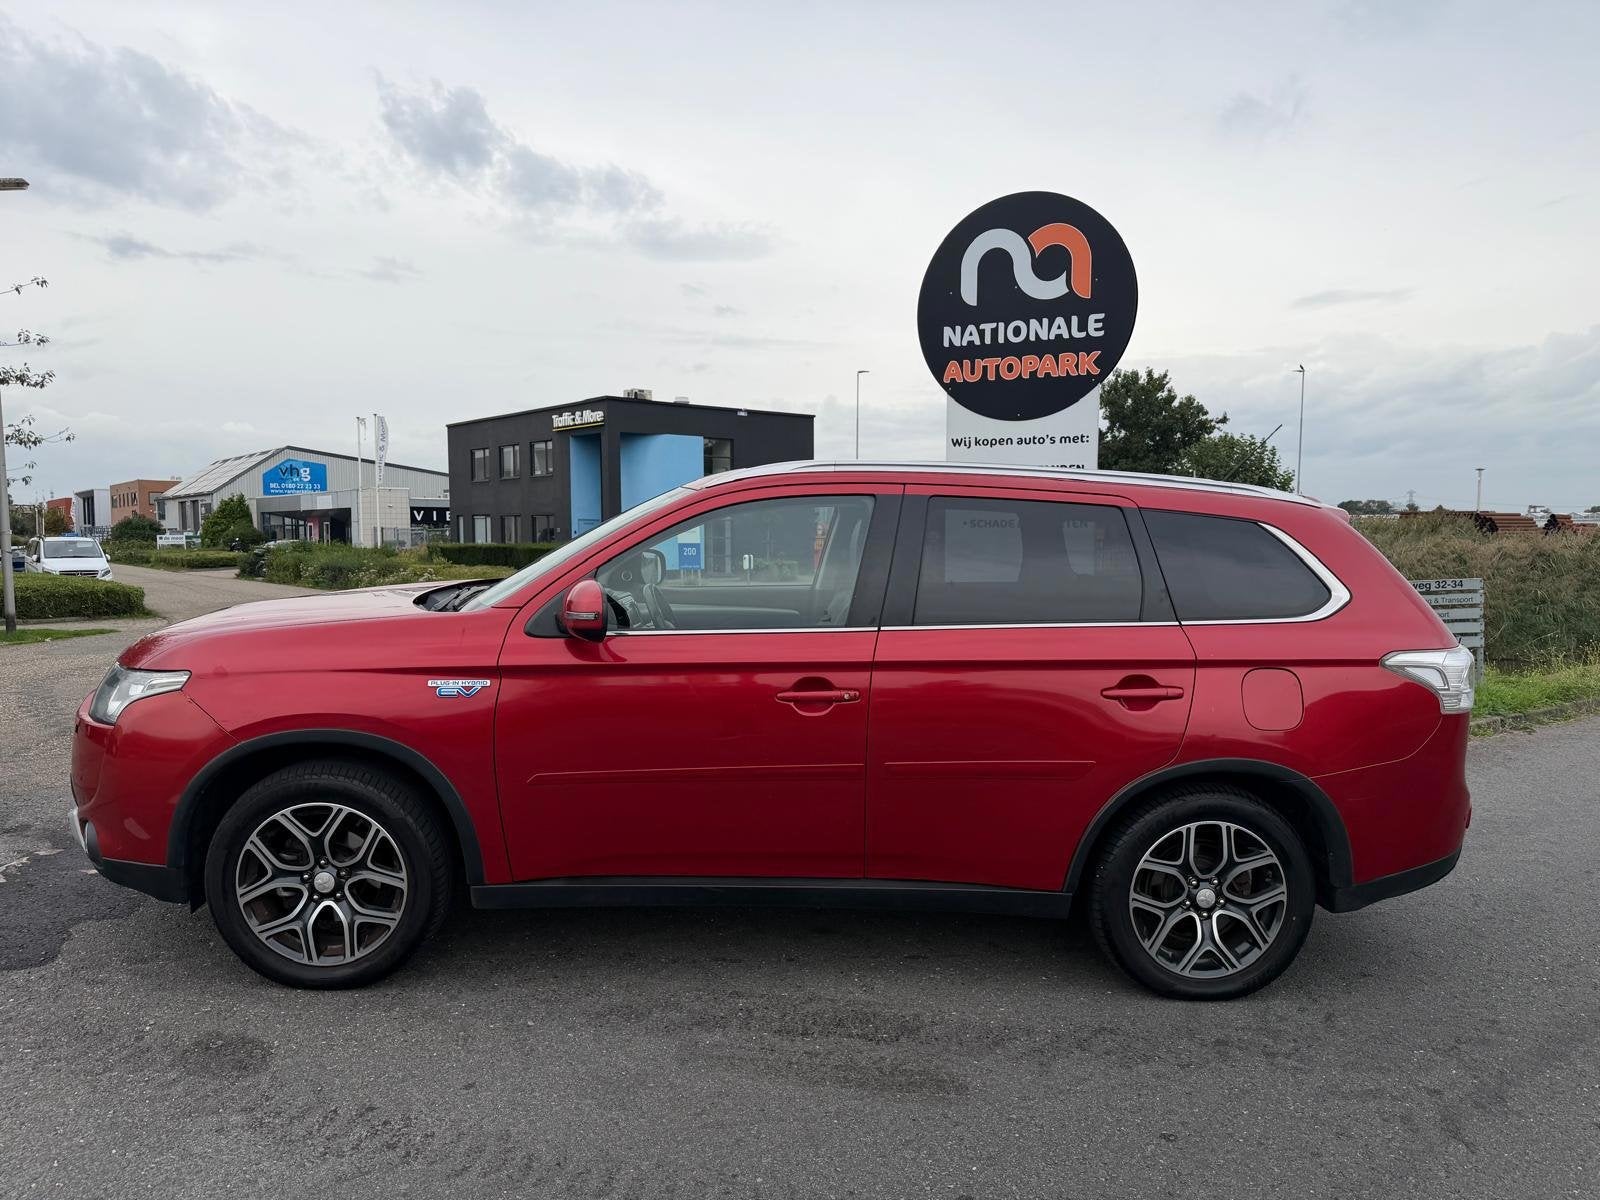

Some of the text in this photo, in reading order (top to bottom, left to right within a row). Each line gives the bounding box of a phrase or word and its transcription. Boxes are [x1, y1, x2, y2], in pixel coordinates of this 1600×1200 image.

[943, 313, 1105, 347] NATIONALE
[943, 351, 1101, 383] AUTOPARK
[552, 409, 604, 428] Traffic & More
[951, 433, 1089, 449] Wij kopen auto's met:
[279, 464, 311, 481] vhg
[970, 520, 1016, 529] SCHADE
[683, 547, 697, 556] 200
[1434, 580, 1463, 589] 32-34
[1441, 596, 1473, 604] Transport
[436, 686, 482, 698] EV
